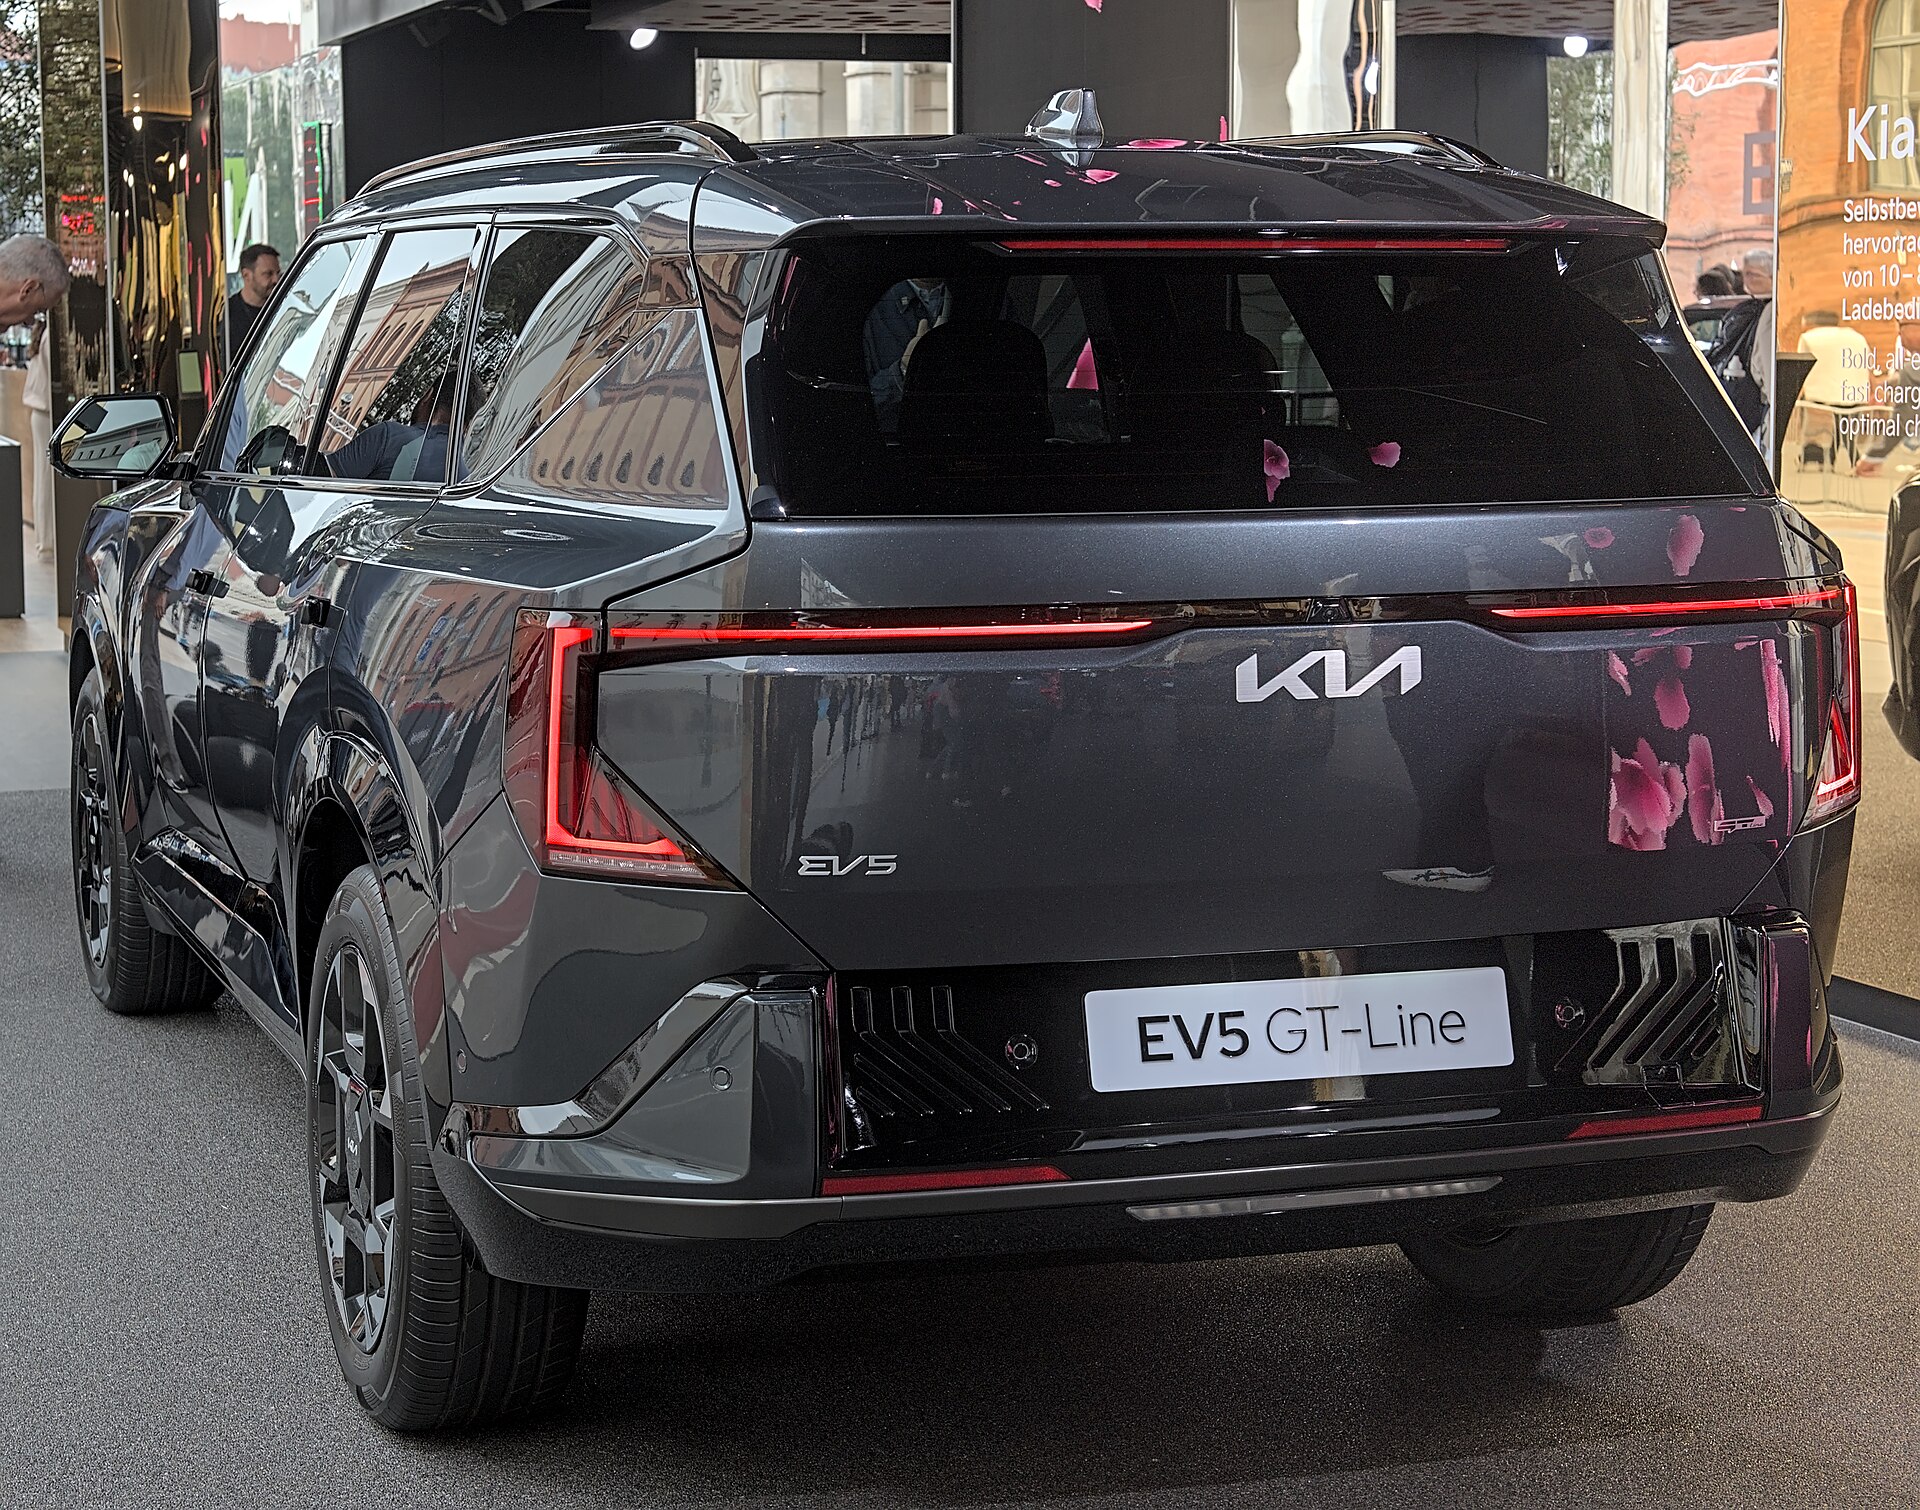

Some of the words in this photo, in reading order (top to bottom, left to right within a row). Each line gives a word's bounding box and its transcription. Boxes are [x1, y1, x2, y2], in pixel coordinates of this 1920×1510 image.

[1847, 103, 1915, 163] Kia
[1843, 196, 1920, 223] Selbstbe
[1842, 269, 1874, 288] von
[1841, 346, 1881, 370] Bold,
[1841, 379, 1871, 402] fast
[1839, 412, 1901, 441] optimal
[798, 854, 898, 876] EV5
[1137, 1009, 1251, 1063] EV5
[1265, 1002, 1468, 1056] GT-Line
